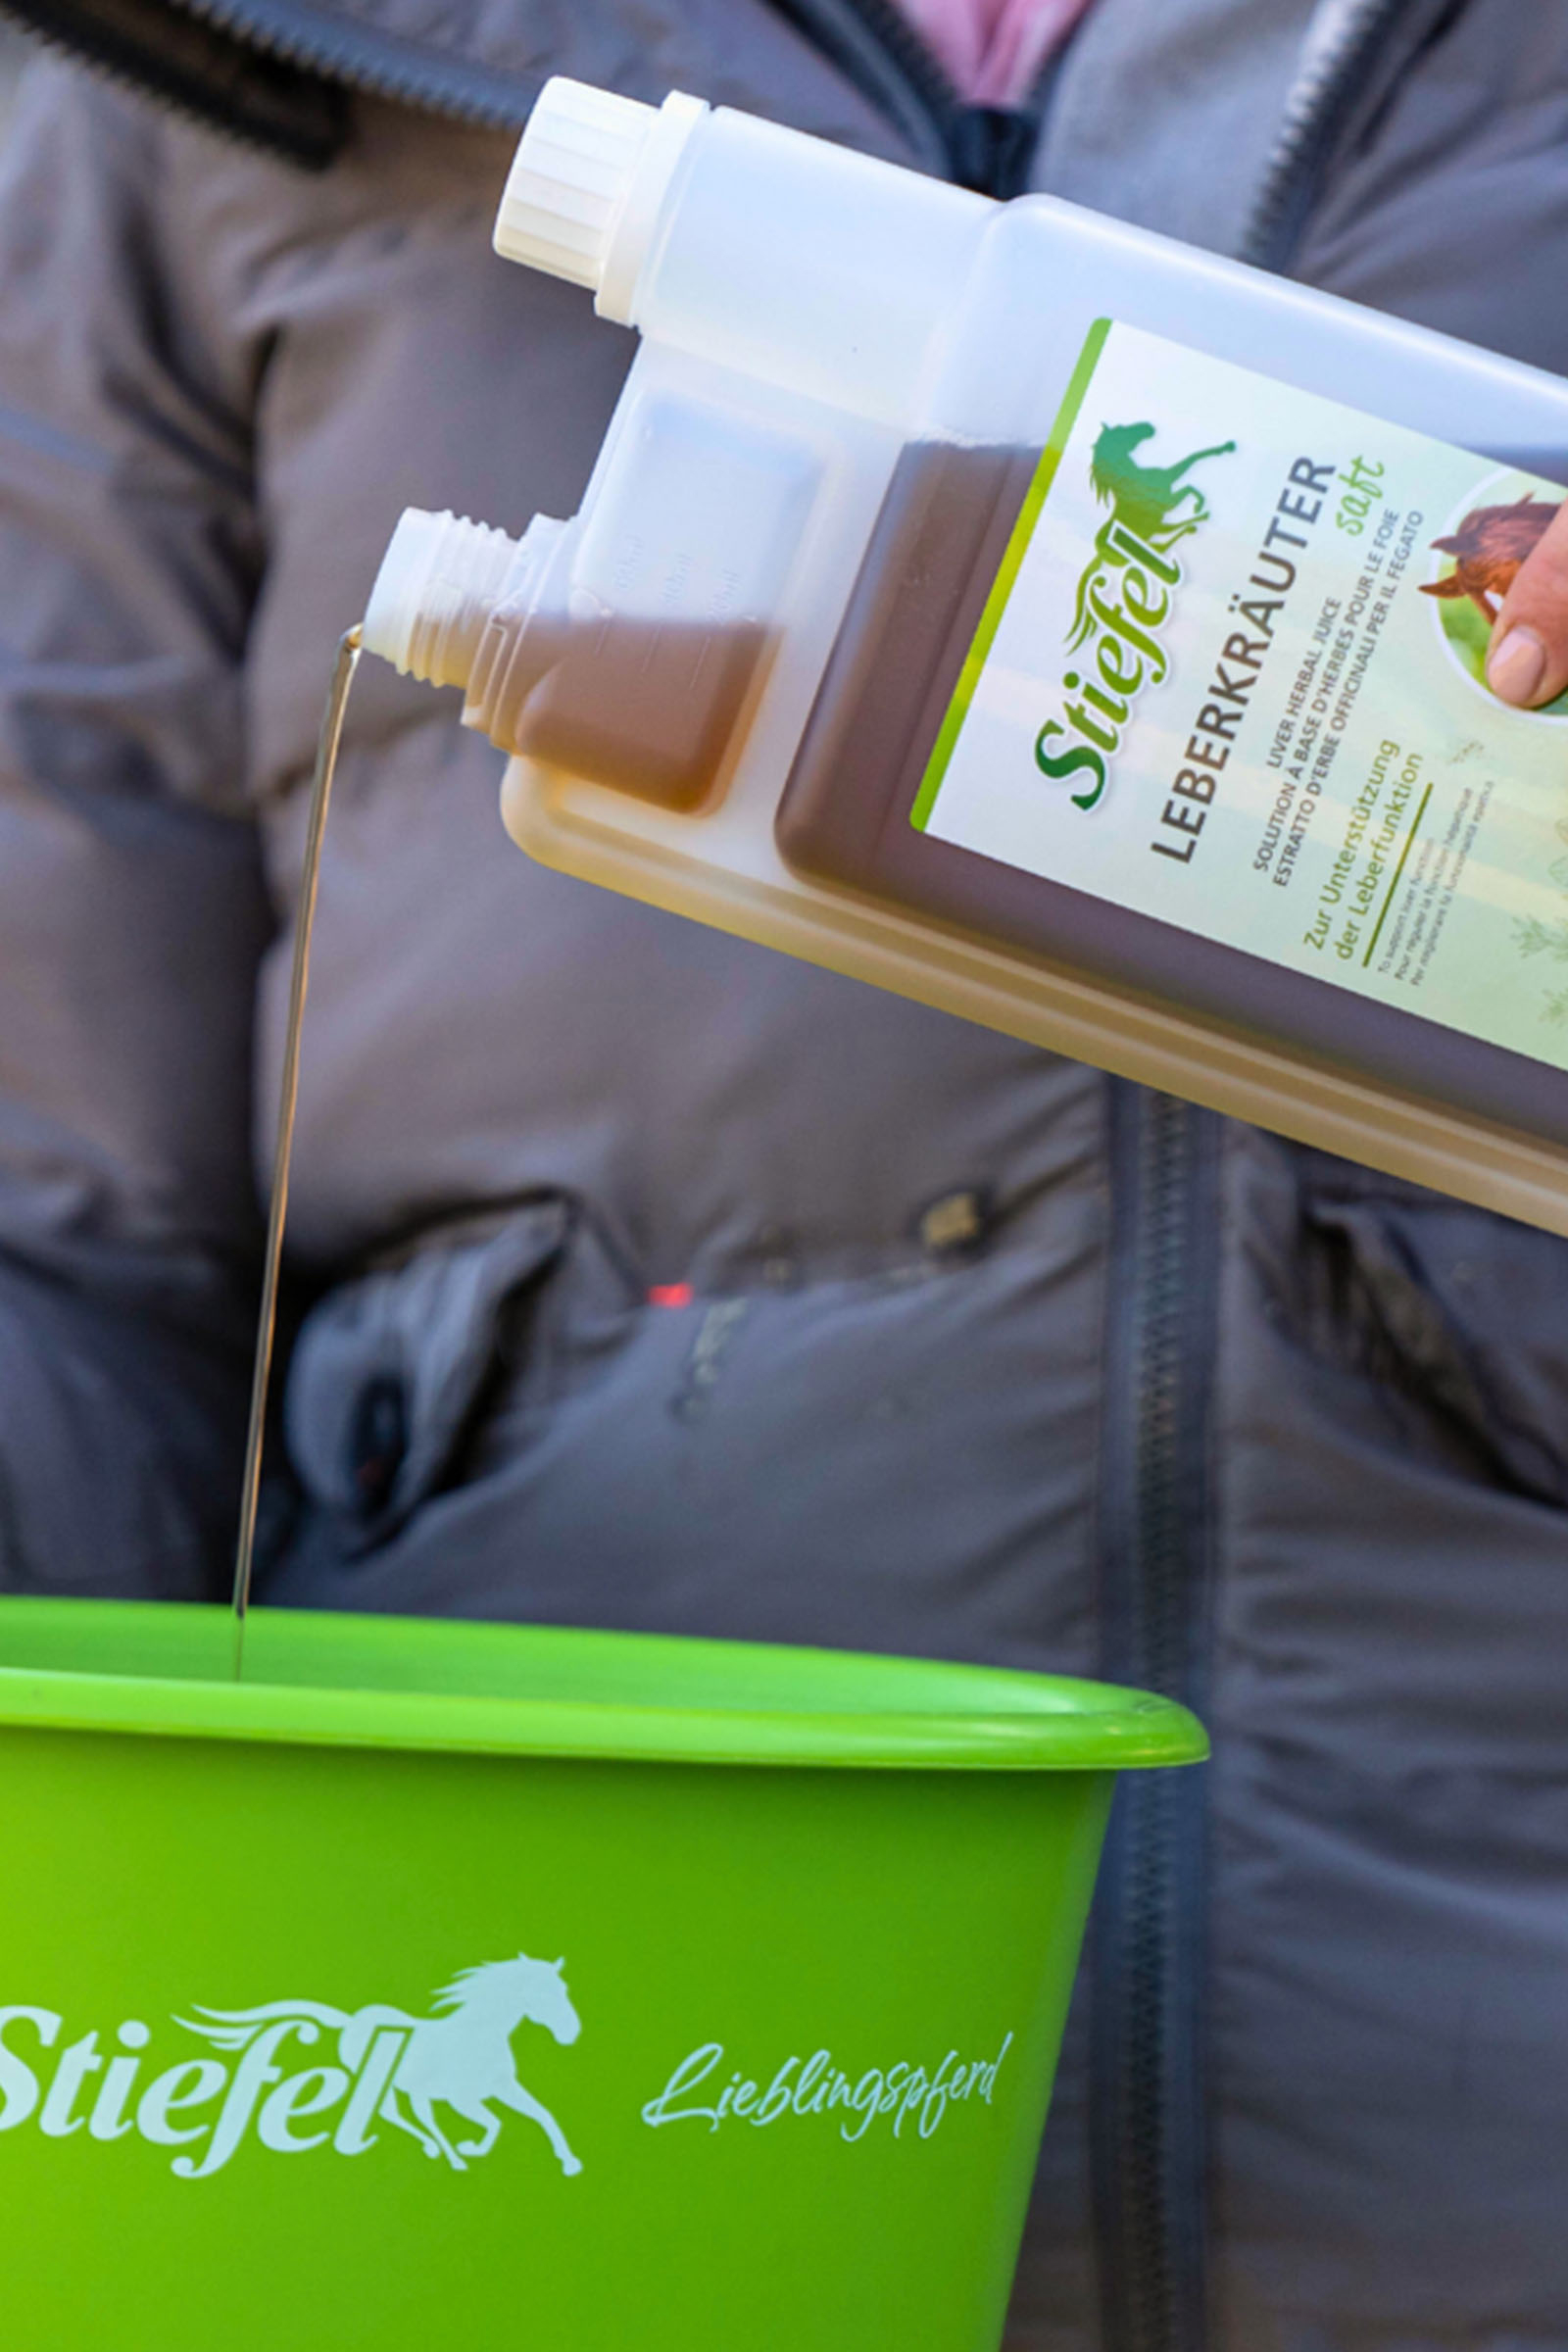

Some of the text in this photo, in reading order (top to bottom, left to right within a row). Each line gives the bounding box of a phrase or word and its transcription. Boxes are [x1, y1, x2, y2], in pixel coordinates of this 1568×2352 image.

[1336, 455, 1385, 536] saft
[1373, 508, 1399, 550] FOIE
[1344, 575, 1374, 626] POUR
[1364, 551, 1384, 573] LE
[1035, 525, 1180, 810] Stiefel
[1151, 457, 1336, 864] LEBERKRÄUTER
[1266, 597, 1341, 768] LIVER HERBAL JUICE
[1273, 511, 1424, 887] ESTRATTO D'ERBE OFFICINALI PER IL FEGATO
[1311, 628, 1354, 713] D'HERBES
[1293, 714, 1322, 762] BASE
[1252, 782, 1298, 872] SOLUTION
[1303, 740, 1400, 951] Zur Unterstützung
[1334, 753, 1423, 960] der Leberfunktion
[0, 2005, 406, 2179] Stiefel
[642, 2031, 1013, 2142] Lieblingspferd
